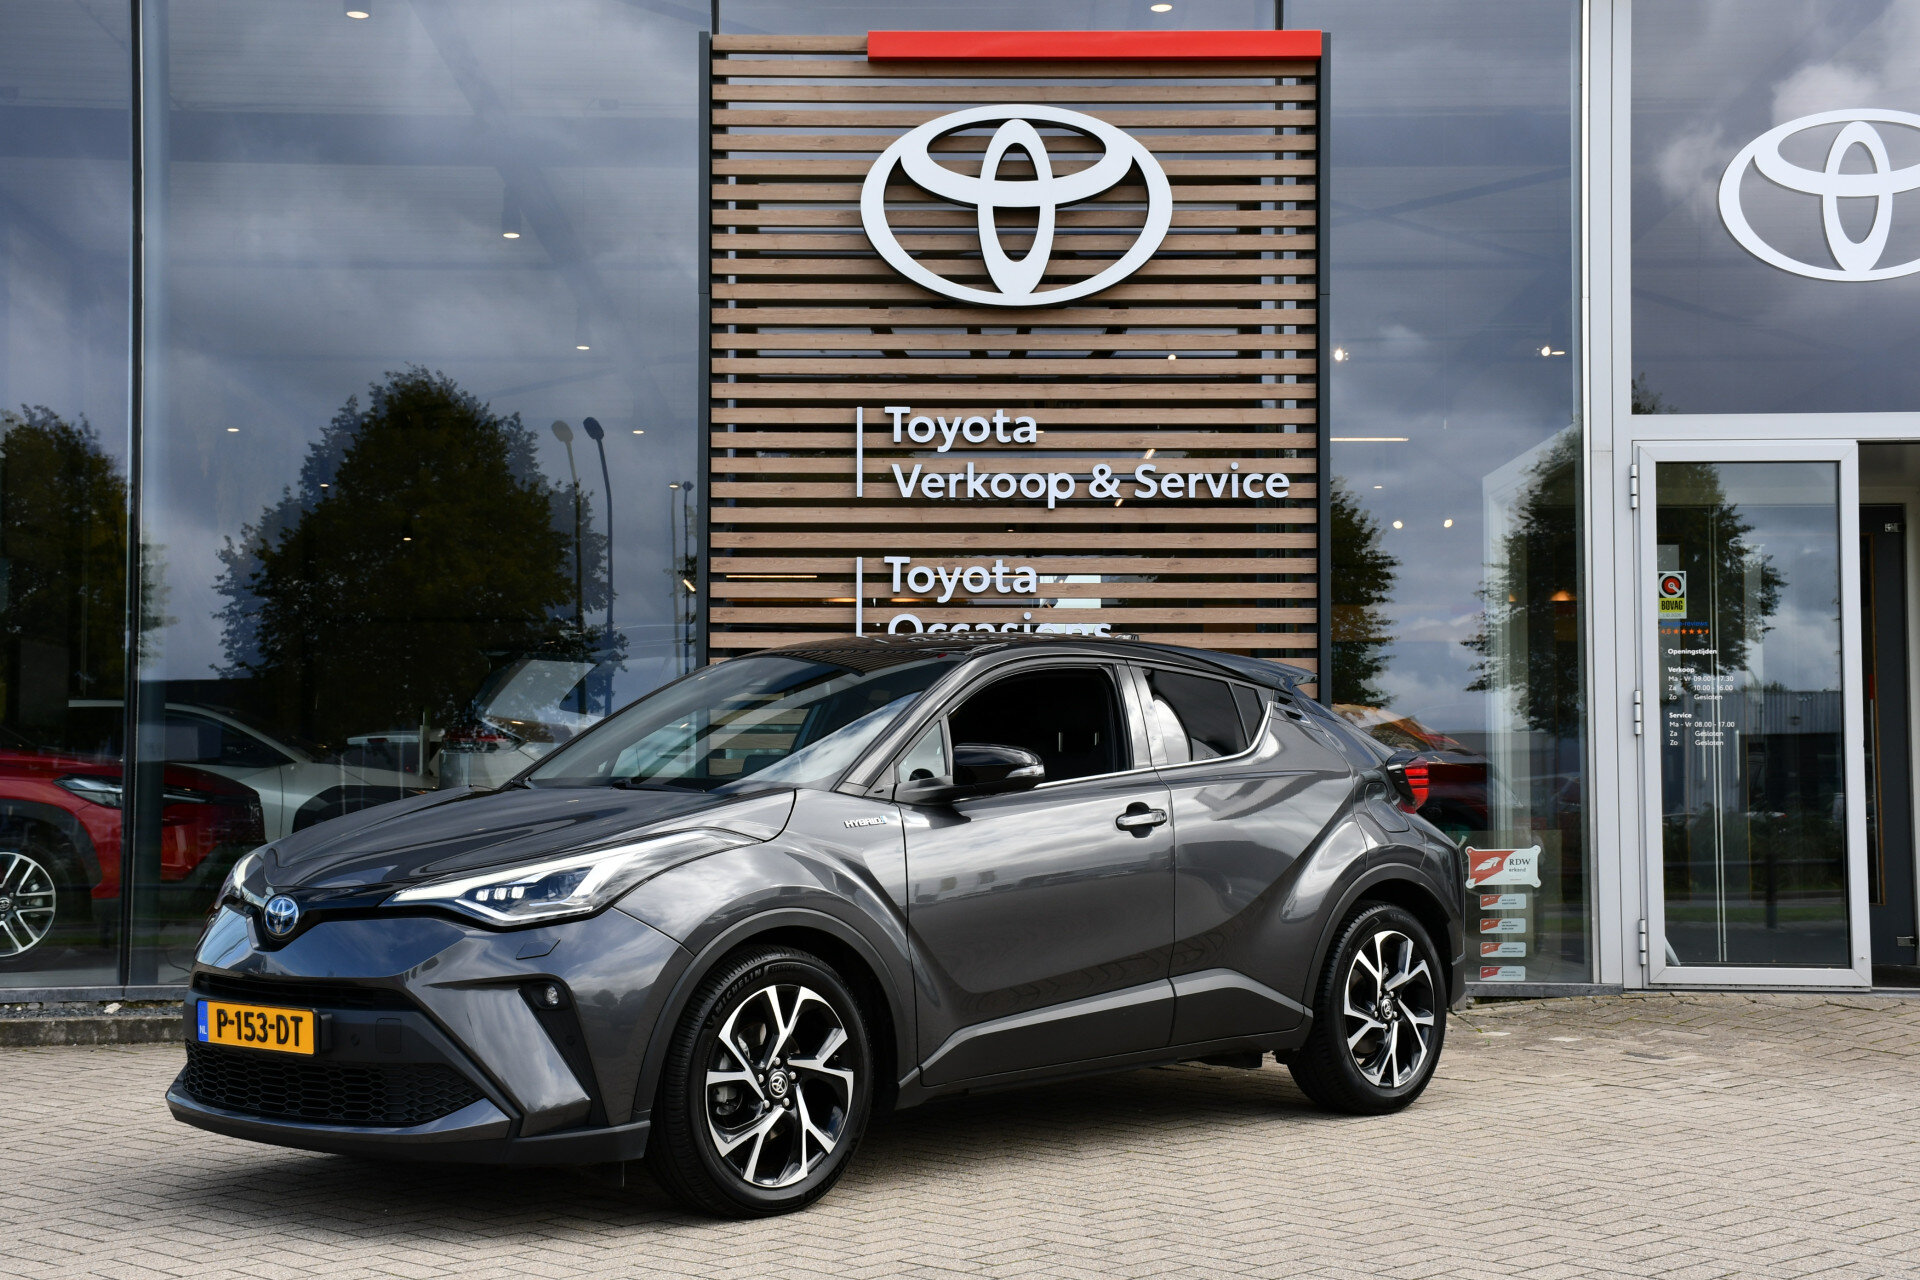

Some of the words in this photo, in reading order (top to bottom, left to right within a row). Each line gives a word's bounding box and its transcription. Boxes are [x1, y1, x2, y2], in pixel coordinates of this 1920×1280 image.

[884, 406, 1037, 452] Toyota
[891, 462, 1076, 509] Verkoop
[1088, 463, 1121, 498] &
[1134, 462, 1290, 499] Service
[884, 556, 1037, 603] Toyota
[1661, 600, 1683, 611] BOVAG
[1667, 648, 1717, 656] Openingstijden
[843, 816, 881, 828] HYBRID
[1509, 858, 1531, 866] RDW
[715, 965, 762, 1014] MICHELIN
[199, 1024, 208, 1035] NL
[216, 1008, 303, 1047] P-153-DT
